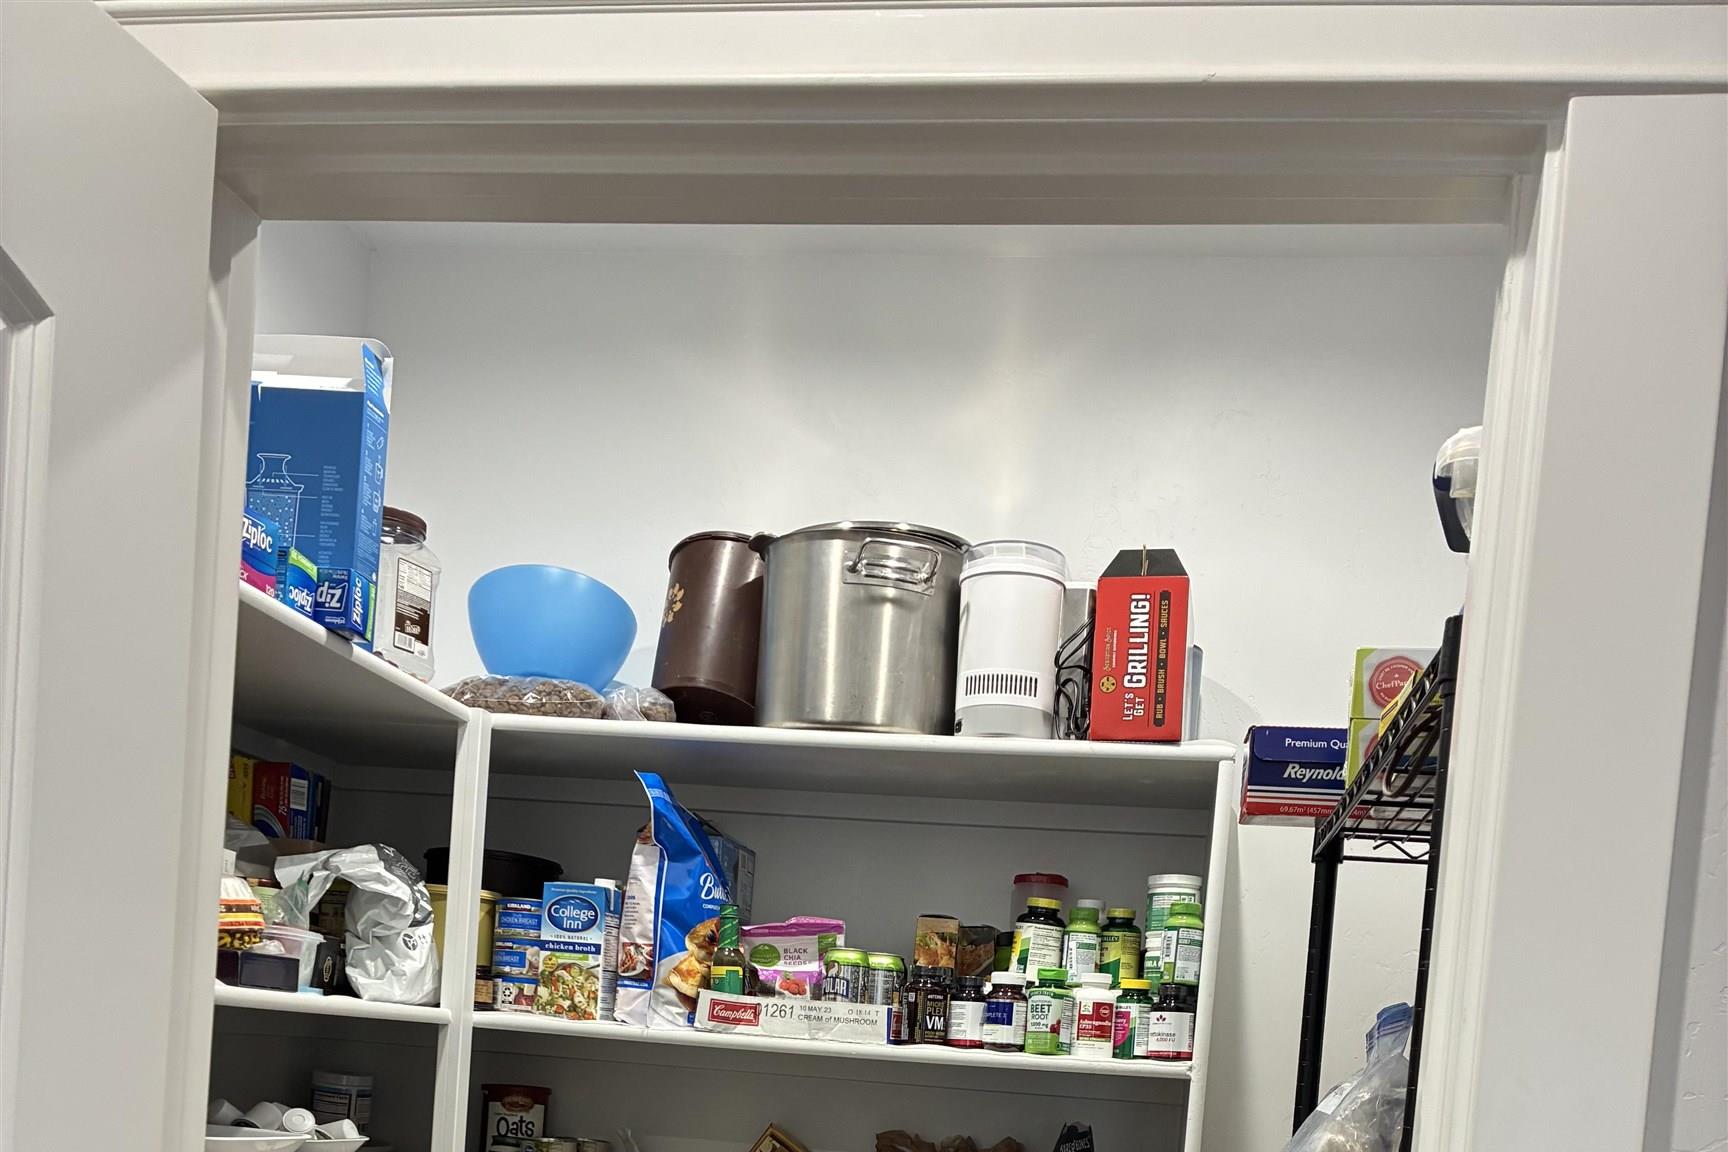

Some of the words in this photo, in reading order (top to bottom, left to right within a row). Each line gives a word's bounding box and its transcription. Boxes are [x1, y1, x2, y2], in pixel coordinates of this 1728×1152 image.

[1161, 600, 1169, 628] SAUCES
[1124, 593, 1151, 688] GRILLING!
[1159, 638, 1167, 659] BOWL
[1157, 669, 1166, 694] BRUSH
[1122, 692, 1134, 720] LET'S
[1134, 697, 1145, 717] GET
[1156, 704, 1165, 720] RUB
[1285, 738, 1328, 749] Premium
[1330, 739, 1349, 750] Qua
[551, 905, 595, 922] College
[563, 919, 582, 929] Inn
[545, 942, 573, 951] chicken
[575, 943, 596, 952] broth
[713, 1004, 754, 1022] Campbell's
[1031, 1004, 1051, 1014] BEET
[798, 1015, 823, 1023] CREAM
[834, 1017, 877, 1026] MUSHROOM
[926, 1016, 944, 1030] VM
[497, 1116, 535, 1138] Oats
